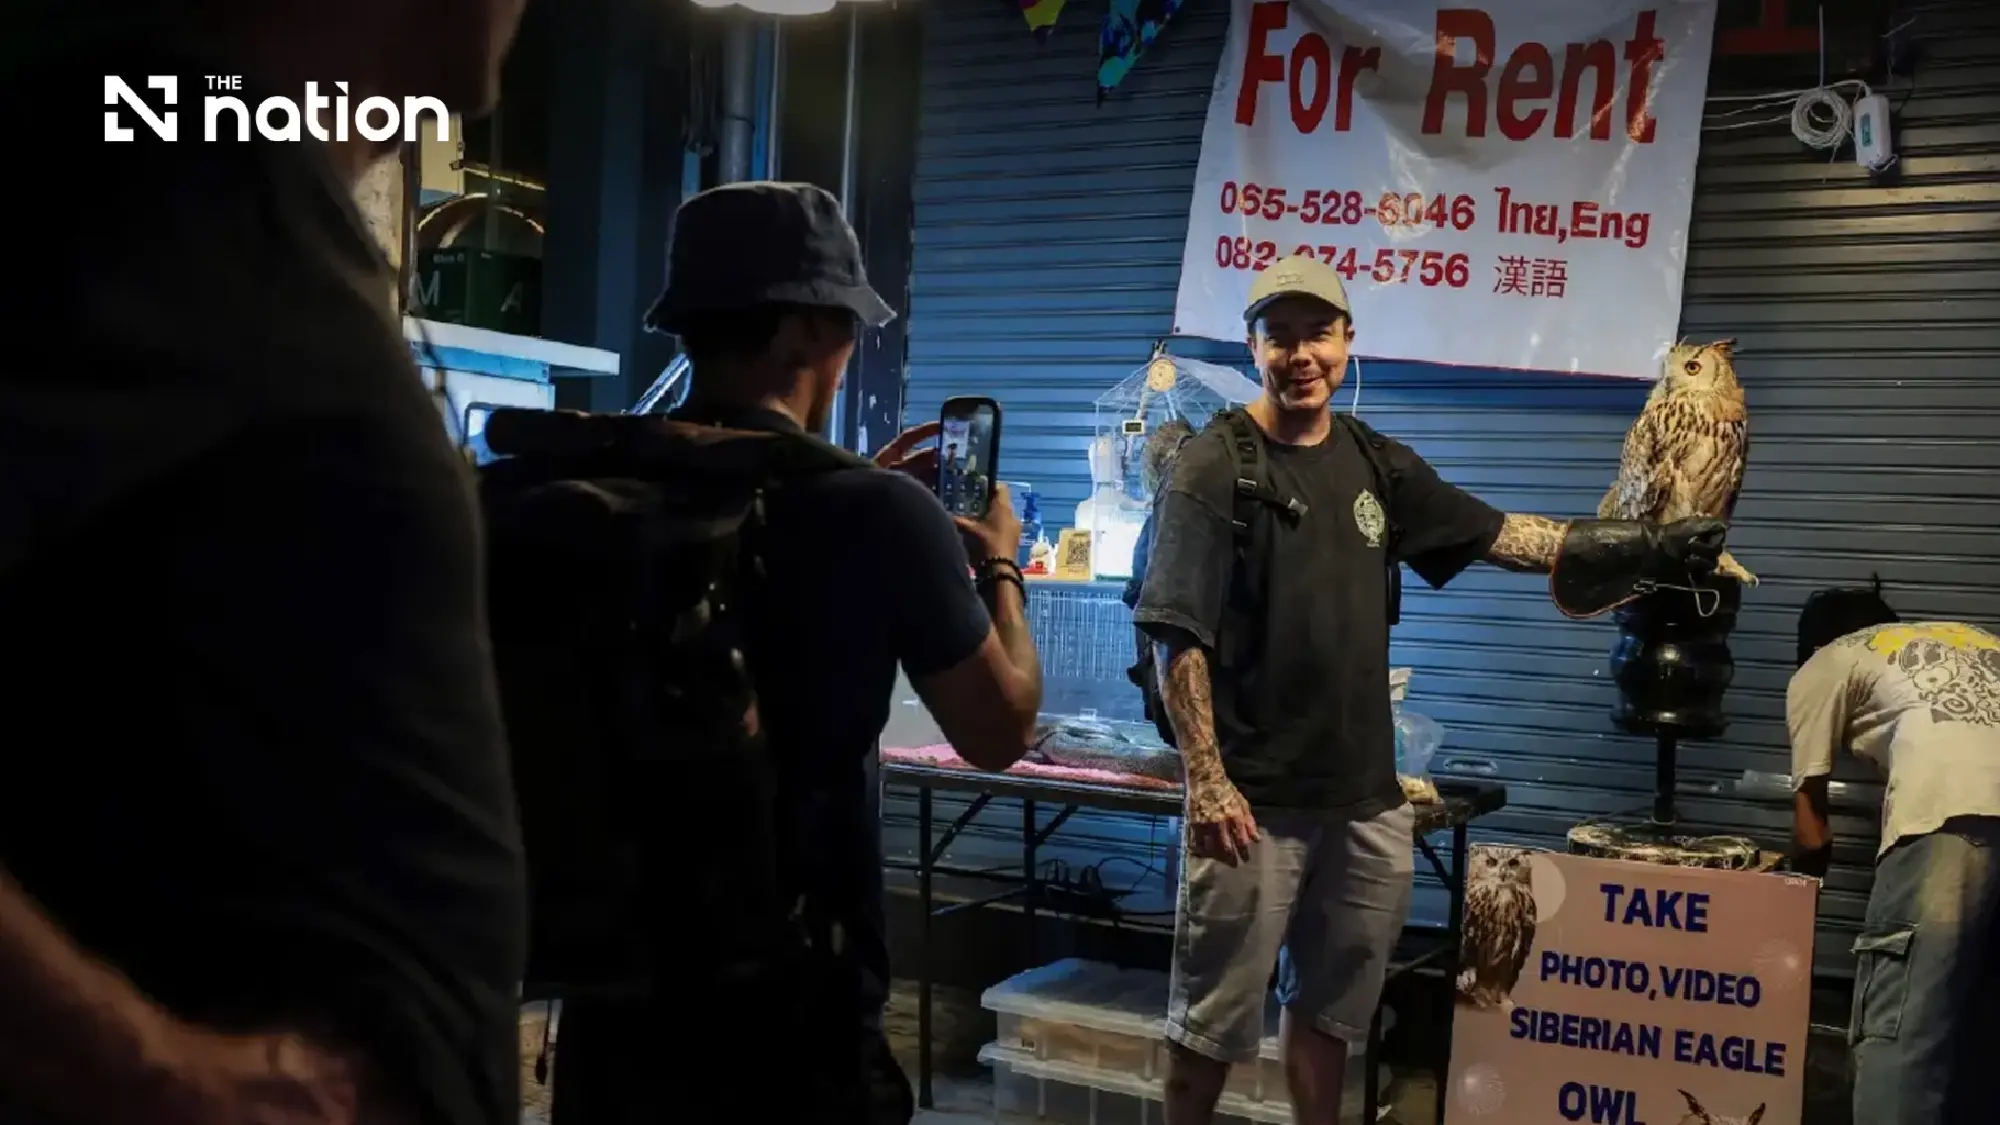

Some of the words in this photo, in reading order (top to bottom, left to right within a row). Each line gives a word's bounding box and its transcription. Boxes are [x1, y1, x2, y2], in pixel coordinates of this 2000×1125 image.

[1235, 1, 1381, 134] For
[1421, 8, 1665, 145] Rent
[1220, 181, 1476, 231] 065-528-6046
[1494, 186, 1652, 249] ไทย,Eng
[1216, 235, 1470, 288] 08274-5756
[1492, 255, 1568, 298] 漢語
[1600, 883, 1710, 933] TAKE
[1540, 950, 1762, 1008] PHOTO,VIDEO
[1509, 1007, 1661, 1059] SIBERIAN
[1673, 1029, 1787, 1077] EAGLE
[1558, 1081, 1647, 1125] OWL
